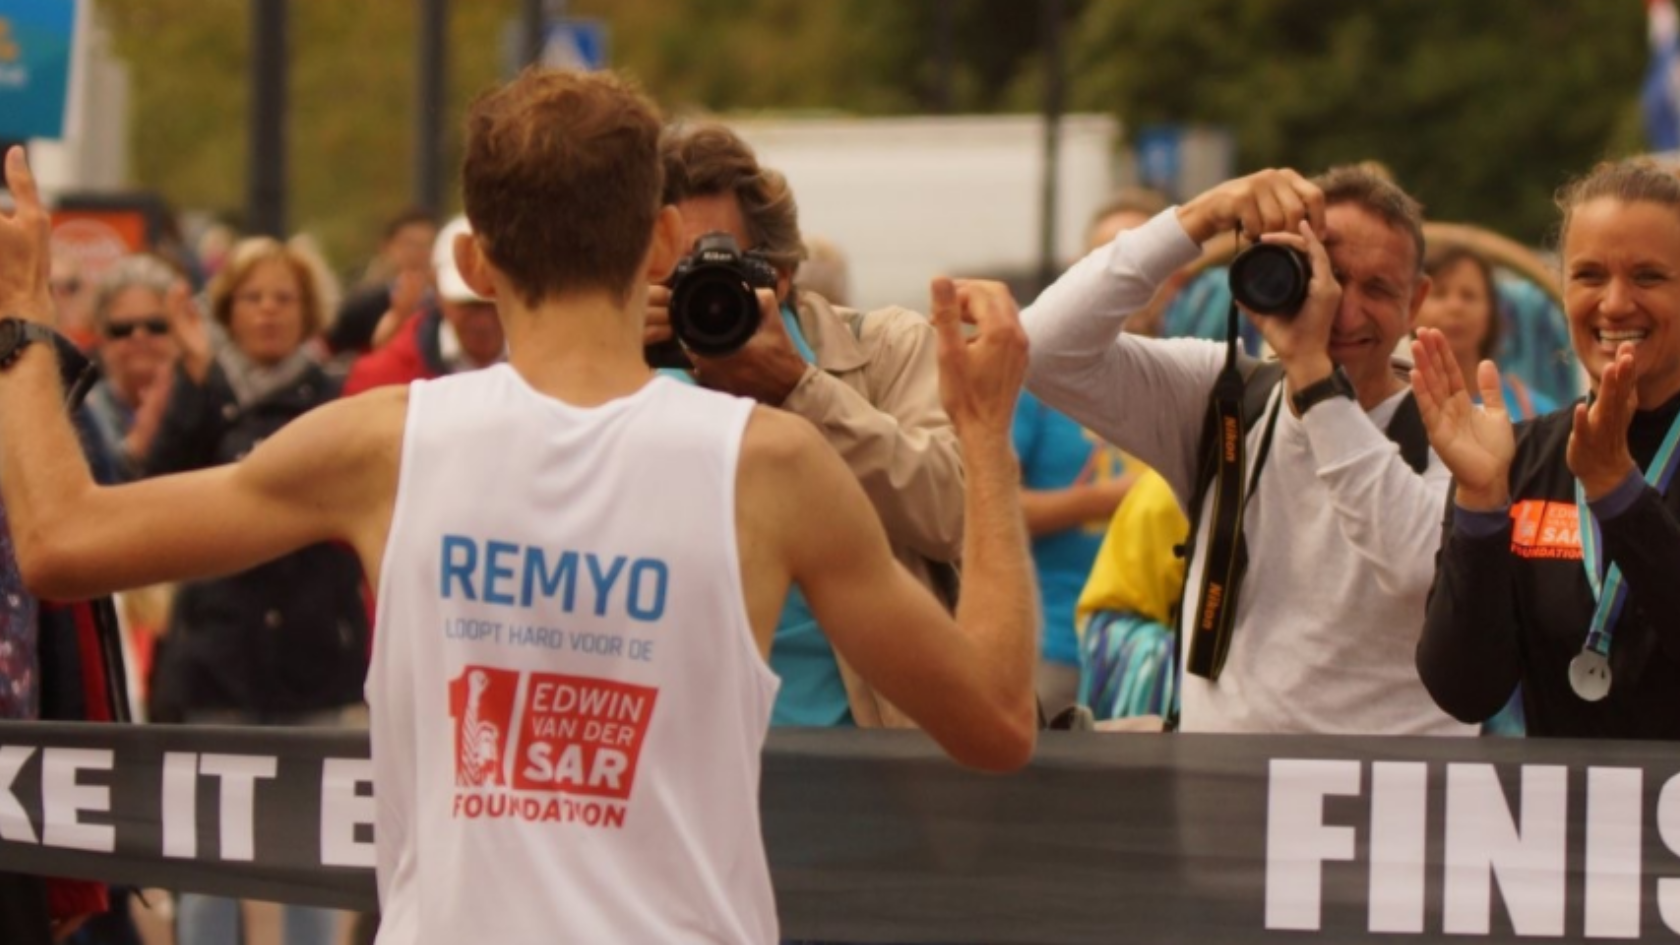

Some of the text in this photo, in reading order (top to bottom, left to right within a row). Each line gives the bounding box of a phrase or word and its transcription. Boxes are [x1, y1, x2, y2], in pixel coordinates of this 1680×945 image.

[702, 252, 732, 260] Nikon
[1224, 416, 1238, 462] Nikon
[440, 534, 669, 622] REMYO
[1202, 582, 1223, 630] Nikon
[445, 618, 655, 661] LOOPT HARD VOOR DE
[531, 682, 645, 723] EDWIN
[532, 715, 636, 746] VAN DER
[522, 740, 629, 790] SAR
[162, 752, 278, 861] IT
[1265, 758, 1680, 939] FINI
